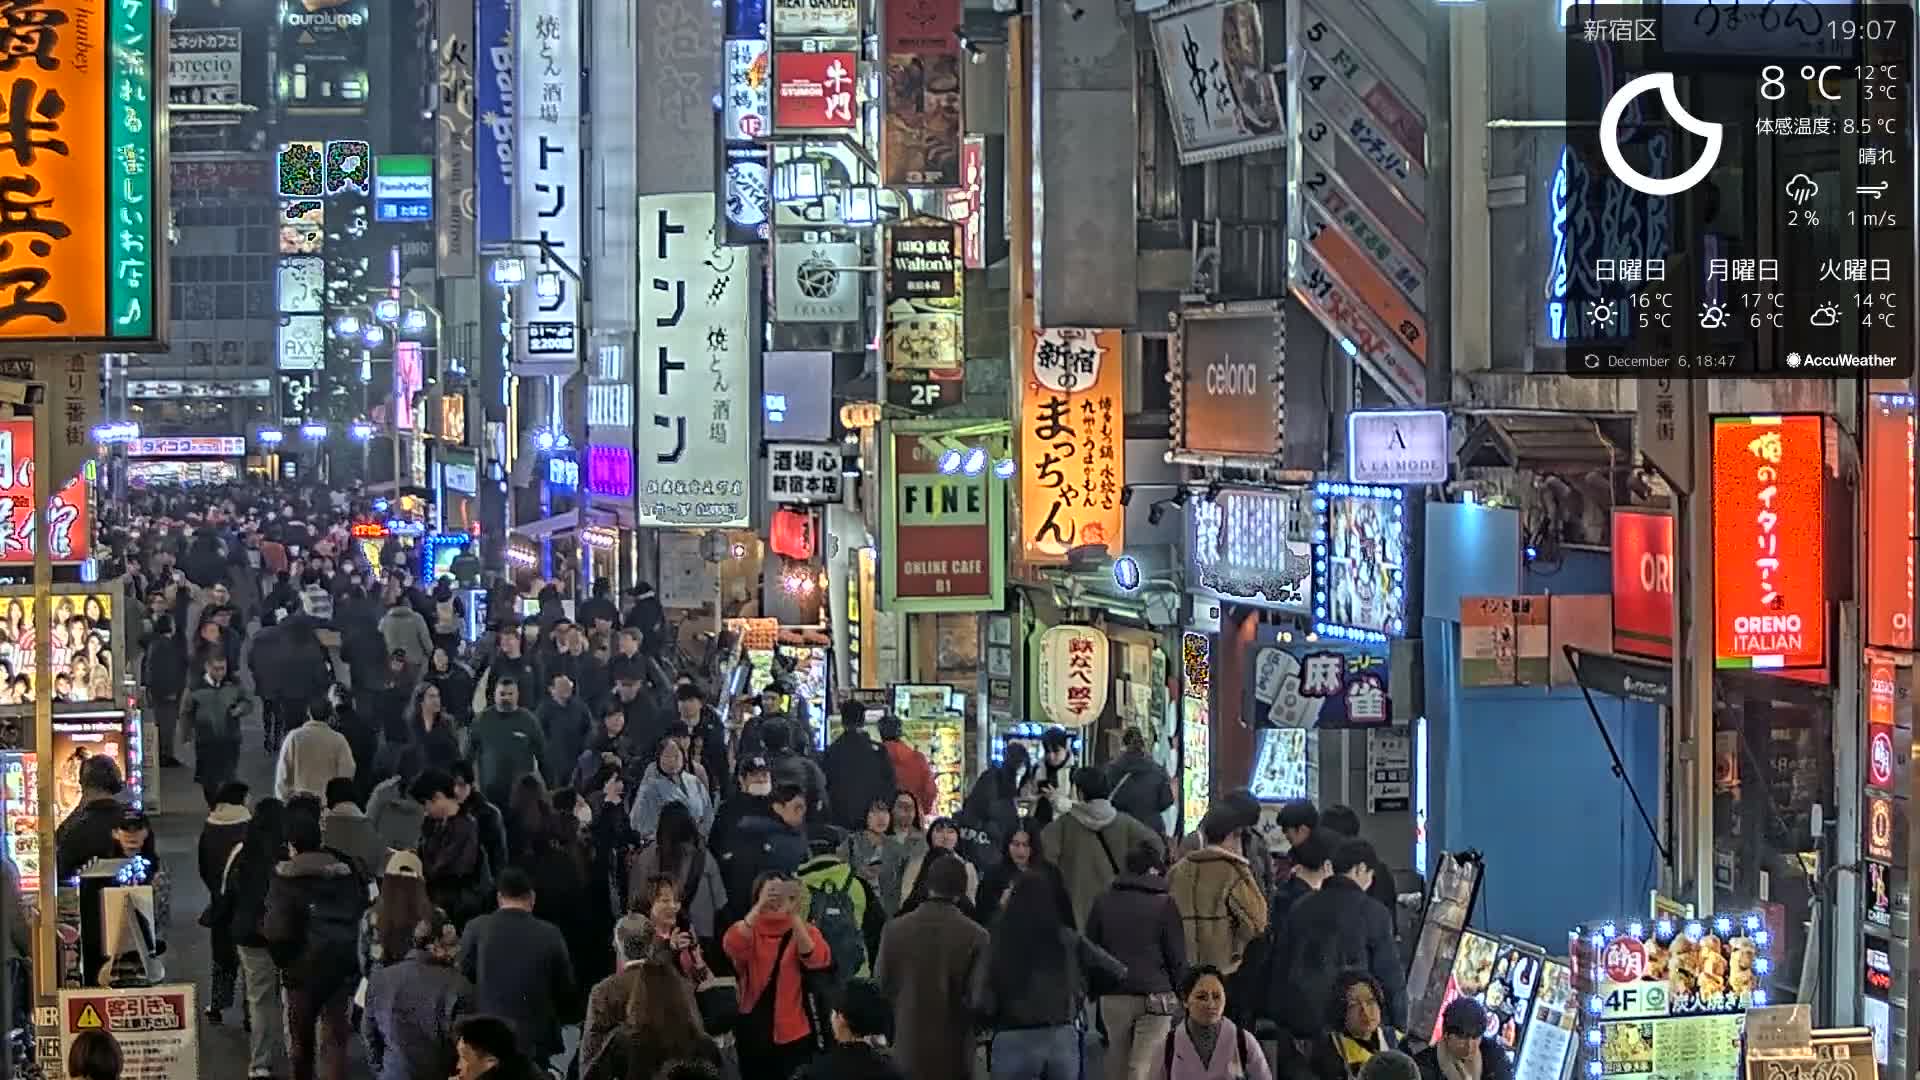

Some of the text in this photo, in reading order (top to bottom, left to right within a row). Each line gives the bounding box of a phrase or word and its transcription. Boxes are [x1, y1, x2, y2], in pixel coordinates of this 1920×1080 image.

[1307, 22, 1328, 42] 5
[824, 59, 853, 121] 牛門
[1308, 75, 1326, 91] 4
[1308, 123, 1327, 142] 3
[1307, 173, 1327, 192] 2
[655, 210, 687, 464] トントン
[1206, 352, 1257, 395] celona
[911, 385, 941, 405] 2F
[773, 450, 838, 472] 酒場心
[1035, 396, 1079, 546] まっちゃん
[772, 475, 839, 495] 新宿本店
[905, 486, 980, 513] FINE
[904, 560, 982, 575] ONLINE CAFE
[1733, 614, 1802, 634] ORENO
[1733, 632, 1803, 652] ITALIAN
[1304, 653, 1386, 720] 麻雀
[1605, 990, 1638, 1011] 4F
